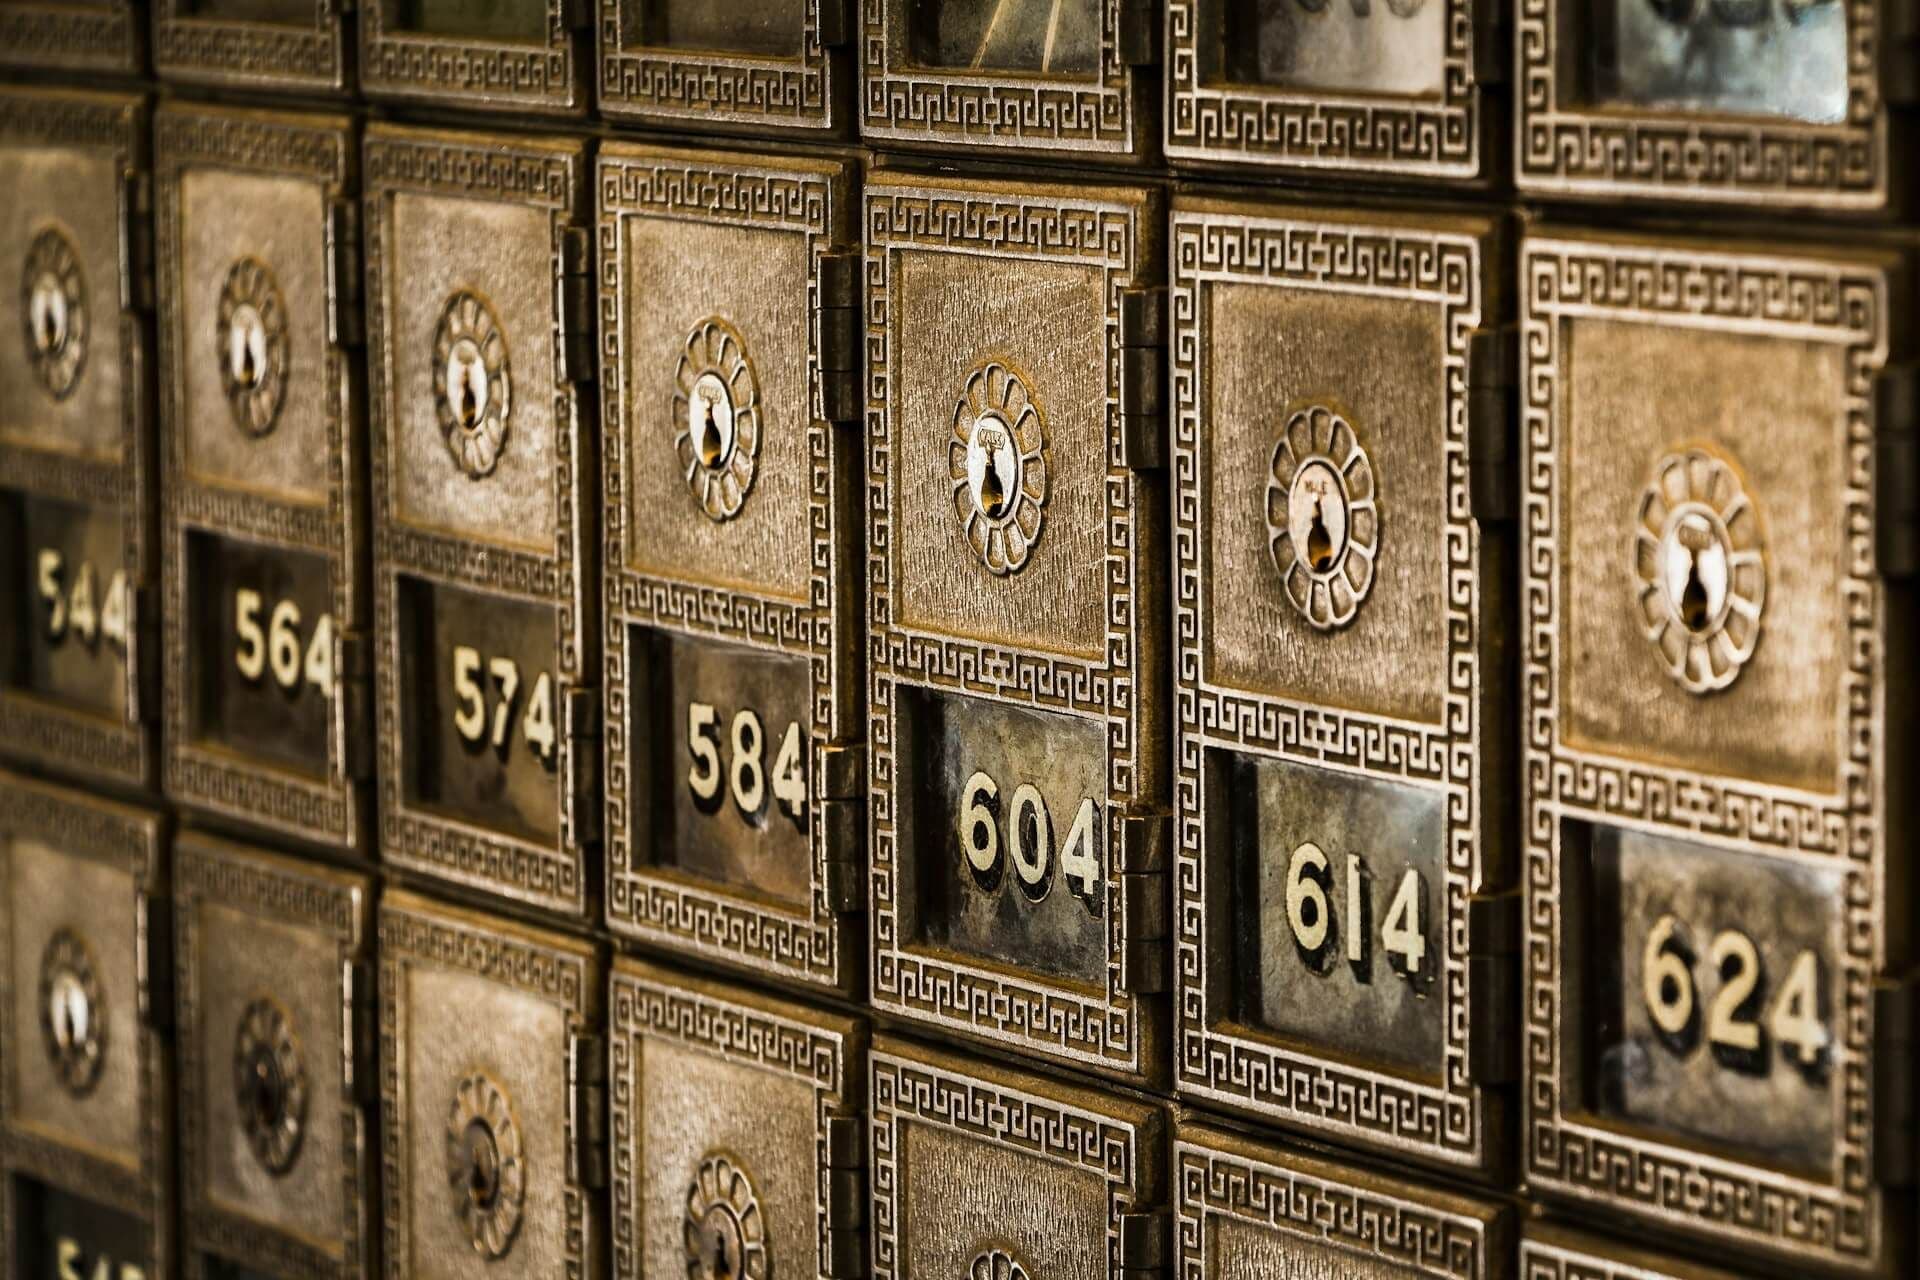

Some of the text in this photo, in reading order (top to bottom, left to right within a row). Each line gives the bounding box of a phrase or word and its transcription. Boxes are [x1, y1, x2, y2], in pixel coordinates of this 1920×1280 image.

[38, 550, 128, 643] 544
[236, 588, 334, 697] 564
[453, 645, 555, 758] 574
[688, 701, 806, 816] 584
[961, 771, 1099, 895] 604
[1286, 842, 1425, 973] 614
[1644, 914, 1828, 1063] 624
